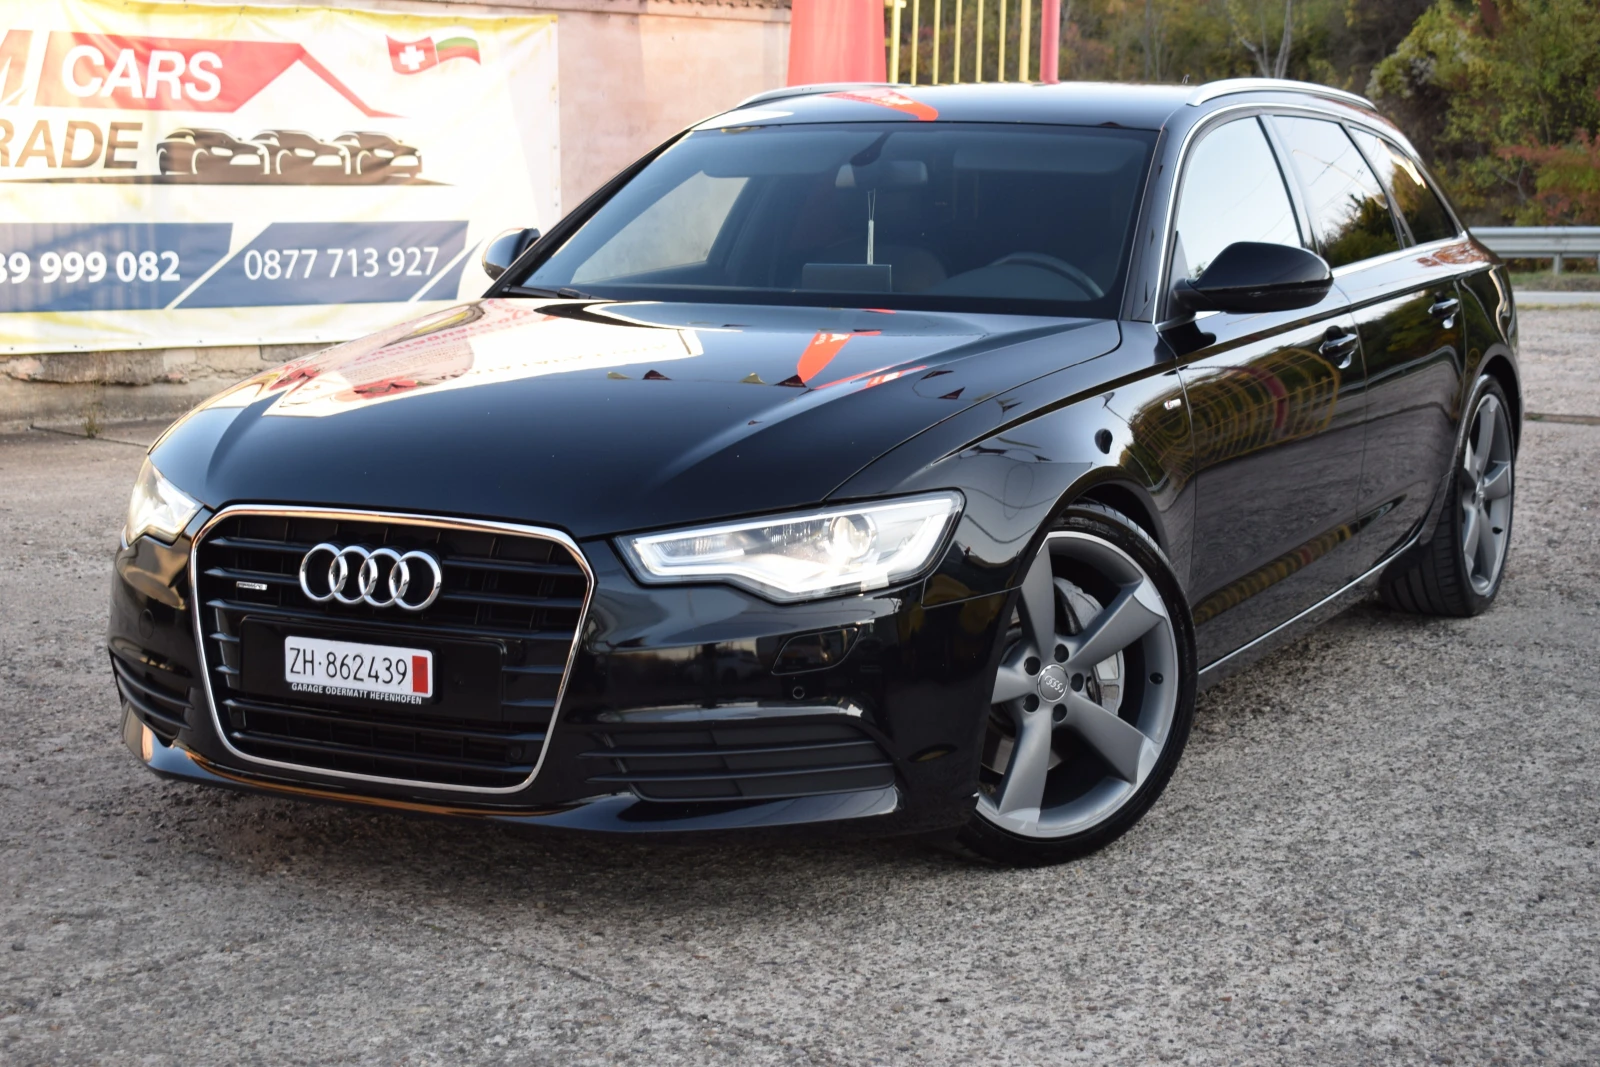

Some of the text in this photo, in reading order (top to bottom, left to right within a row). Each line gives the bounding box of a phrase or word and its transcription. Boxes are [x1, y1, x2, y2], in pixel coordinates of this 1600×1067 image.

[62, 45, 223, 101] CARS
[39, 251, 107, 283] 999
[116, 250, 181, 282] 082
[244, 246, 439, 280] 0877 713 927
[291, 682, 422, 705] GARAGE ODERMATT HEFENHOFEN
